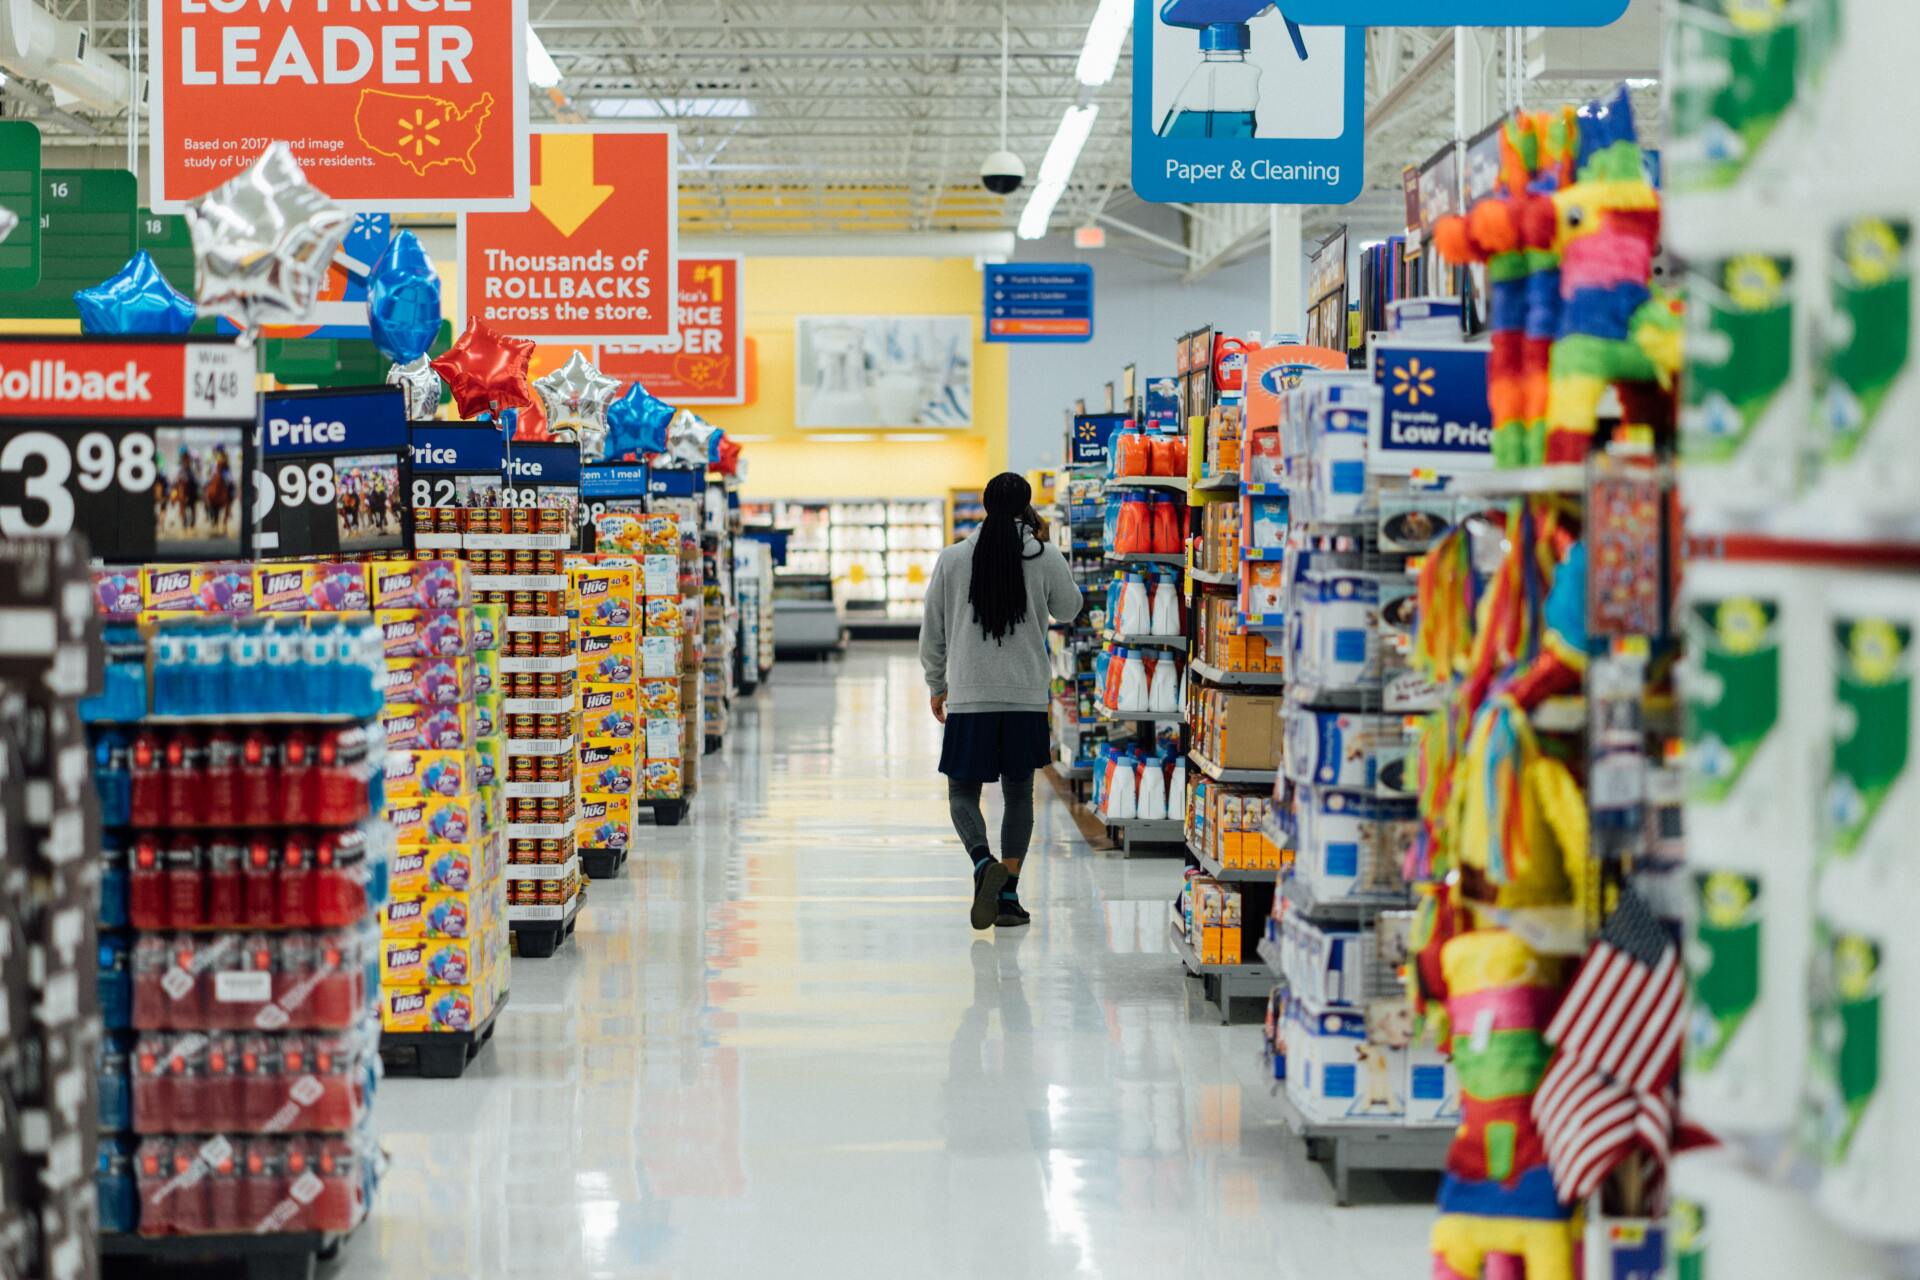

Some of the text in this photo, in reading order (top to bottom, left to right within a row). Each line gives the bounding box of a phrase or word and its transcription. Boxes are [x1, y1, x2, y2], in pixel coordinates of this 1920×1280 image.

[182, 25, 474, 84] LEADER
[184, 138, 219, 150] Based
[222, 141, 238, 150] on
[241, 138, 268, 150] 2017
[308, 138, 344, 152] image
[184, 156, 216, 170] study
[220, 156, 232, 167] of
[318, 156, 376, 167] residents.
[1166, 159, 1340, 186] Paper & Cleaning
[50, 183, 68, 198] 16
[146, 220, 162, 234] 18
[484, 249, 649, 272] Thousands of
[485, 277, 651, 299] ROLLBACKS
[694, 264, 723, 302] #1
[678, 290, 708, 302] rica's
[484, 302, 652, 320] across the store.
[678, 306, 723, 326] RICE
[0, 360, 152, 401] ollback
[269, 416, 346, 446] Price
[1392, 421, 1441, 444] Low
[582, 469, 641, 480] tem 1 meal
[582, 581, 607, 594] HUG
[586, 694, 612, 708] HUG
[582, 804, 605, 818] HUG
